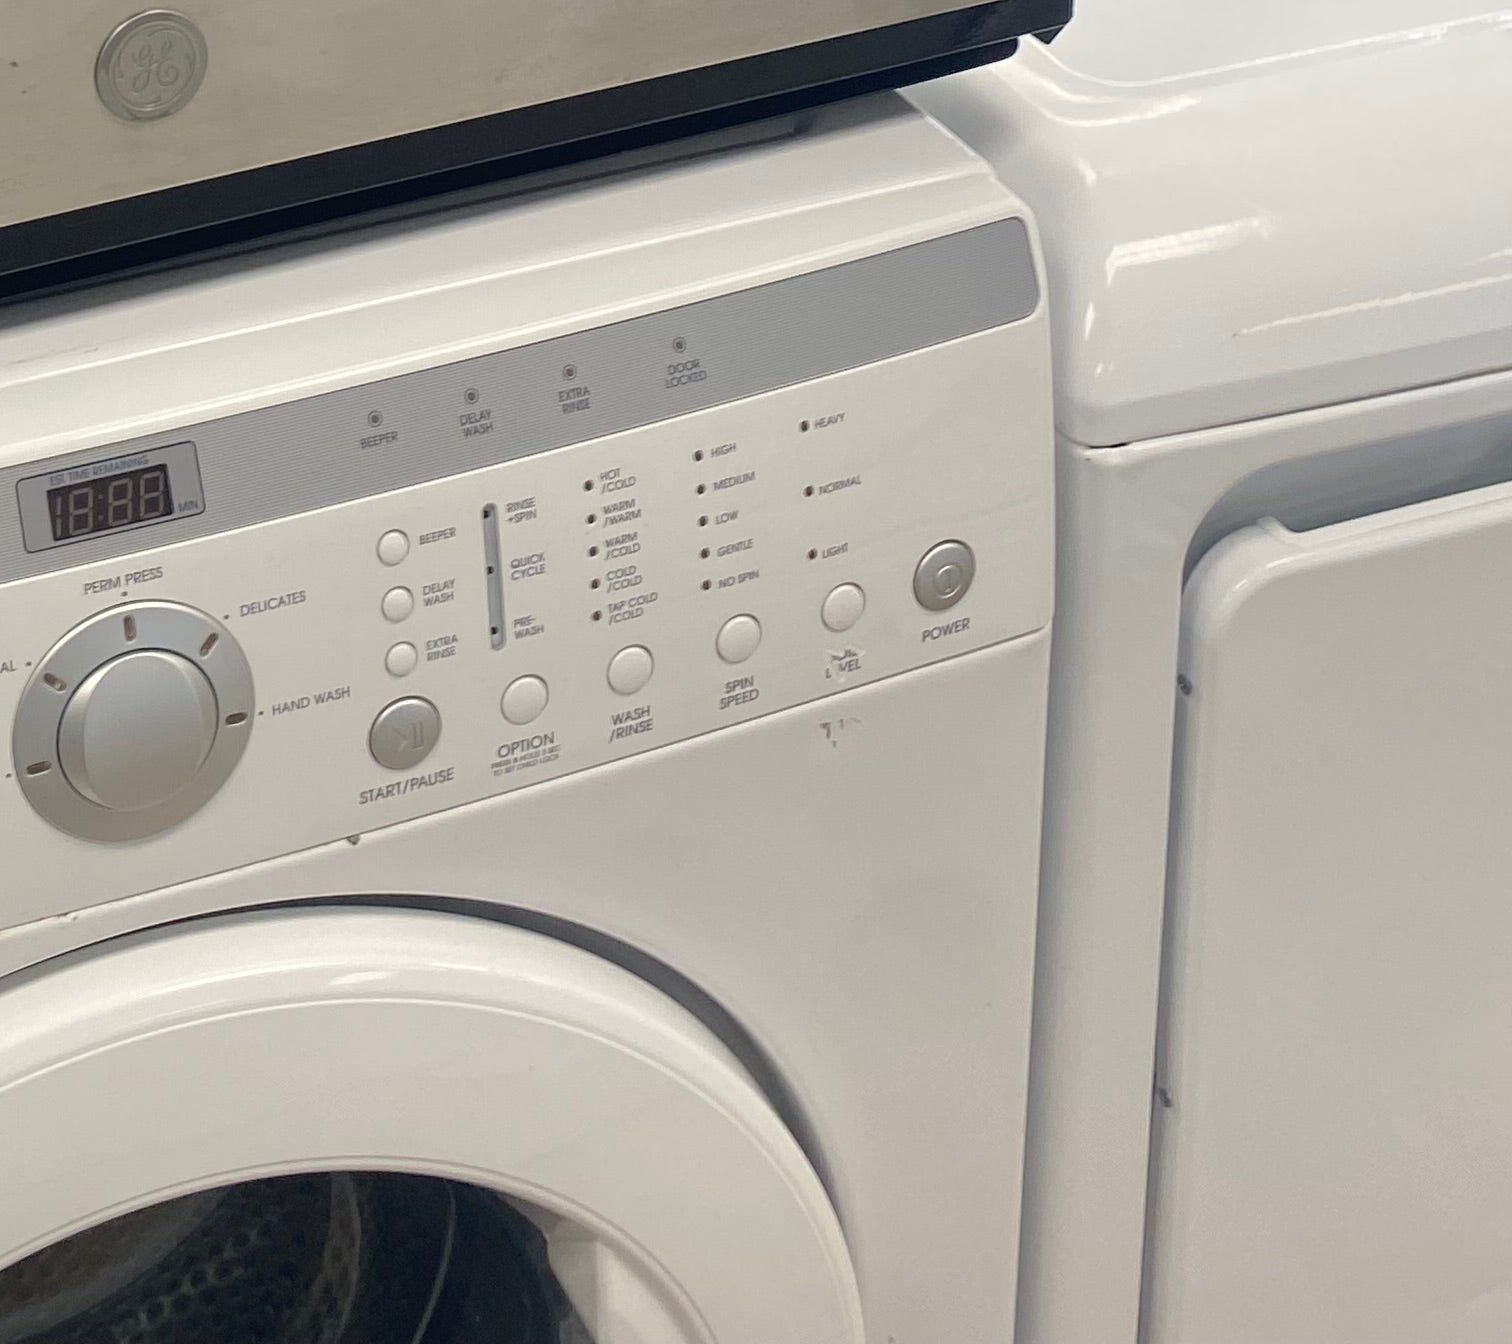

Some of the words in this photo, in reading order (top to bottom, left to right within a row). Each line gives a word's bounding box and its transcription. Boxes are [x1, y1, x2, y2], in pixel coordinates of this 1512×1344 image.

[666, 358, 701, 376] DOOR
[665, 370, 707, 389] LOCKED
[558, 386, 591, 403] EXTRA
[459, 408, 492, 427] DELAY
[814, 412, 845, 430] HEAVY
[462, 422, 494, 439] WASH
[360, 431, 398, 449] BEEPER
[711, 443, 737, 458] HIGH
[600, 467, 621, 482] HOT
[713, 471, 755, 491] MEDIUM
[818, 475, 862, 496] NORMAL
[506, 496, 536, 513] RINSE
[602, 498, 636, 514] WARM
[715, 510, 739, 525] LOW
[419, 527, 456, 545] BEEPER
[605, 531, 638, 548] WARM
[716, 538, 754, 557] GENTLE
[822, 542, 849, 559] LIGHT
[510, 552, 546, 569] QUICK
[83, 575, 122, 595] PERM
[123, 565, 164, 586] PRESS
[510, 563, 546, 581] CYCLE
[605, 565, 637, 582] COLD
[718, 576, 736, 589] NO
[737, 569, 760, 585] SPIN
[422, 578, 456, 596] DELAY
[239, 590, 307, 617] DELICATES
[423, 591, 455, 607] WASH
[607, 600, 626, 614] TAP
[628, 592, 659, 608] COLD
[514, 624, 545, 640] WASH
[921, 617, 971, 643] POWER
[425, 634, 459, 651] EXTRA
[426, 645, 456, 662] RINSE
[824, 658, 862, 679] LVEL
[724, 675, 755, 694] SPIN
[271, 696, 311, 716] HAND
[313, 685, 351, 705] WASH
[719, 688, 760, 710] SPEED
[610, 705, 651, 726] WASH
[497, 730, 555, 758] OPTION
[358, 766, 456, 806] START/PAUSE
